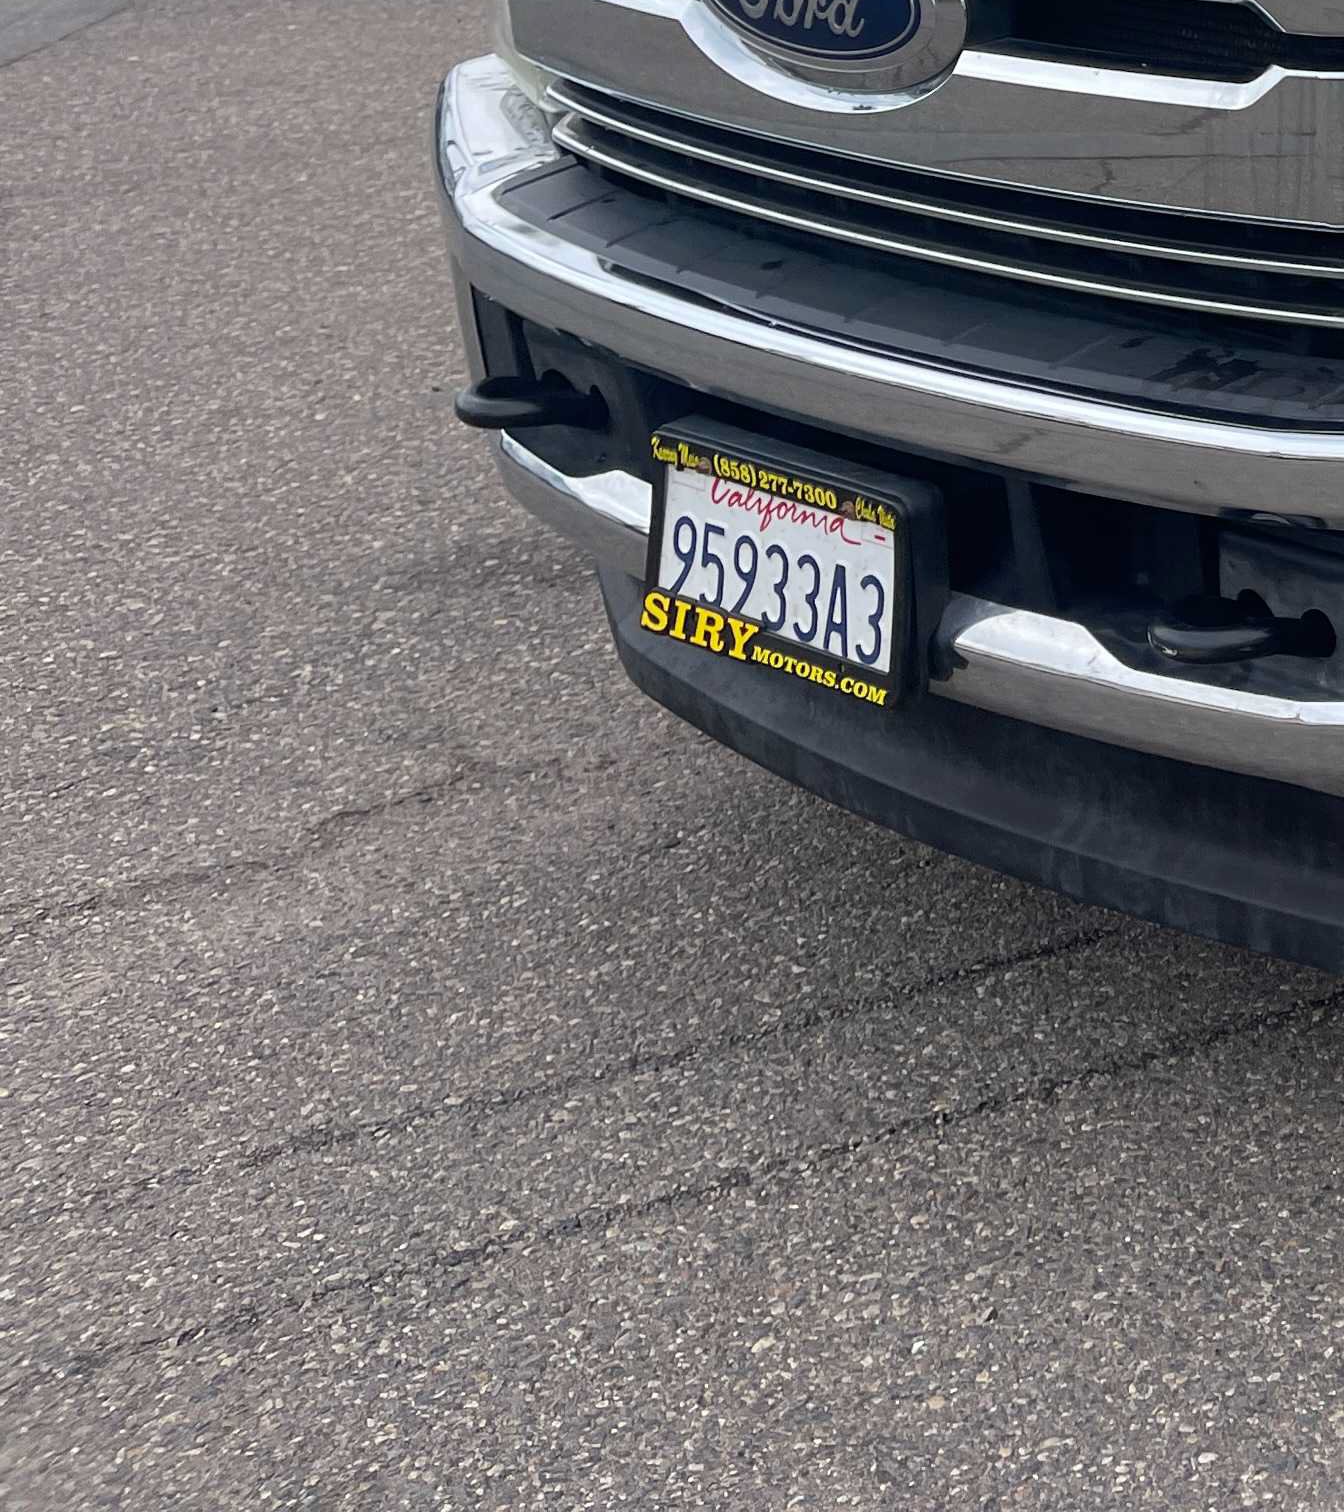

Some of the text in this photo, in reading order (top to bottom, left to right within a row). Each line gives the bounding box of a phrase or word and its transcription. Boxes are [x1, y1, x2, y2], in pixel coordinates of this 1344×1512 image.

[712, 477, 861, 546] California
[713, 452, 757, 489] (858)
[758, 470, 837, 510] 277-7300
[668, 515, 885, 665] 95933A3
